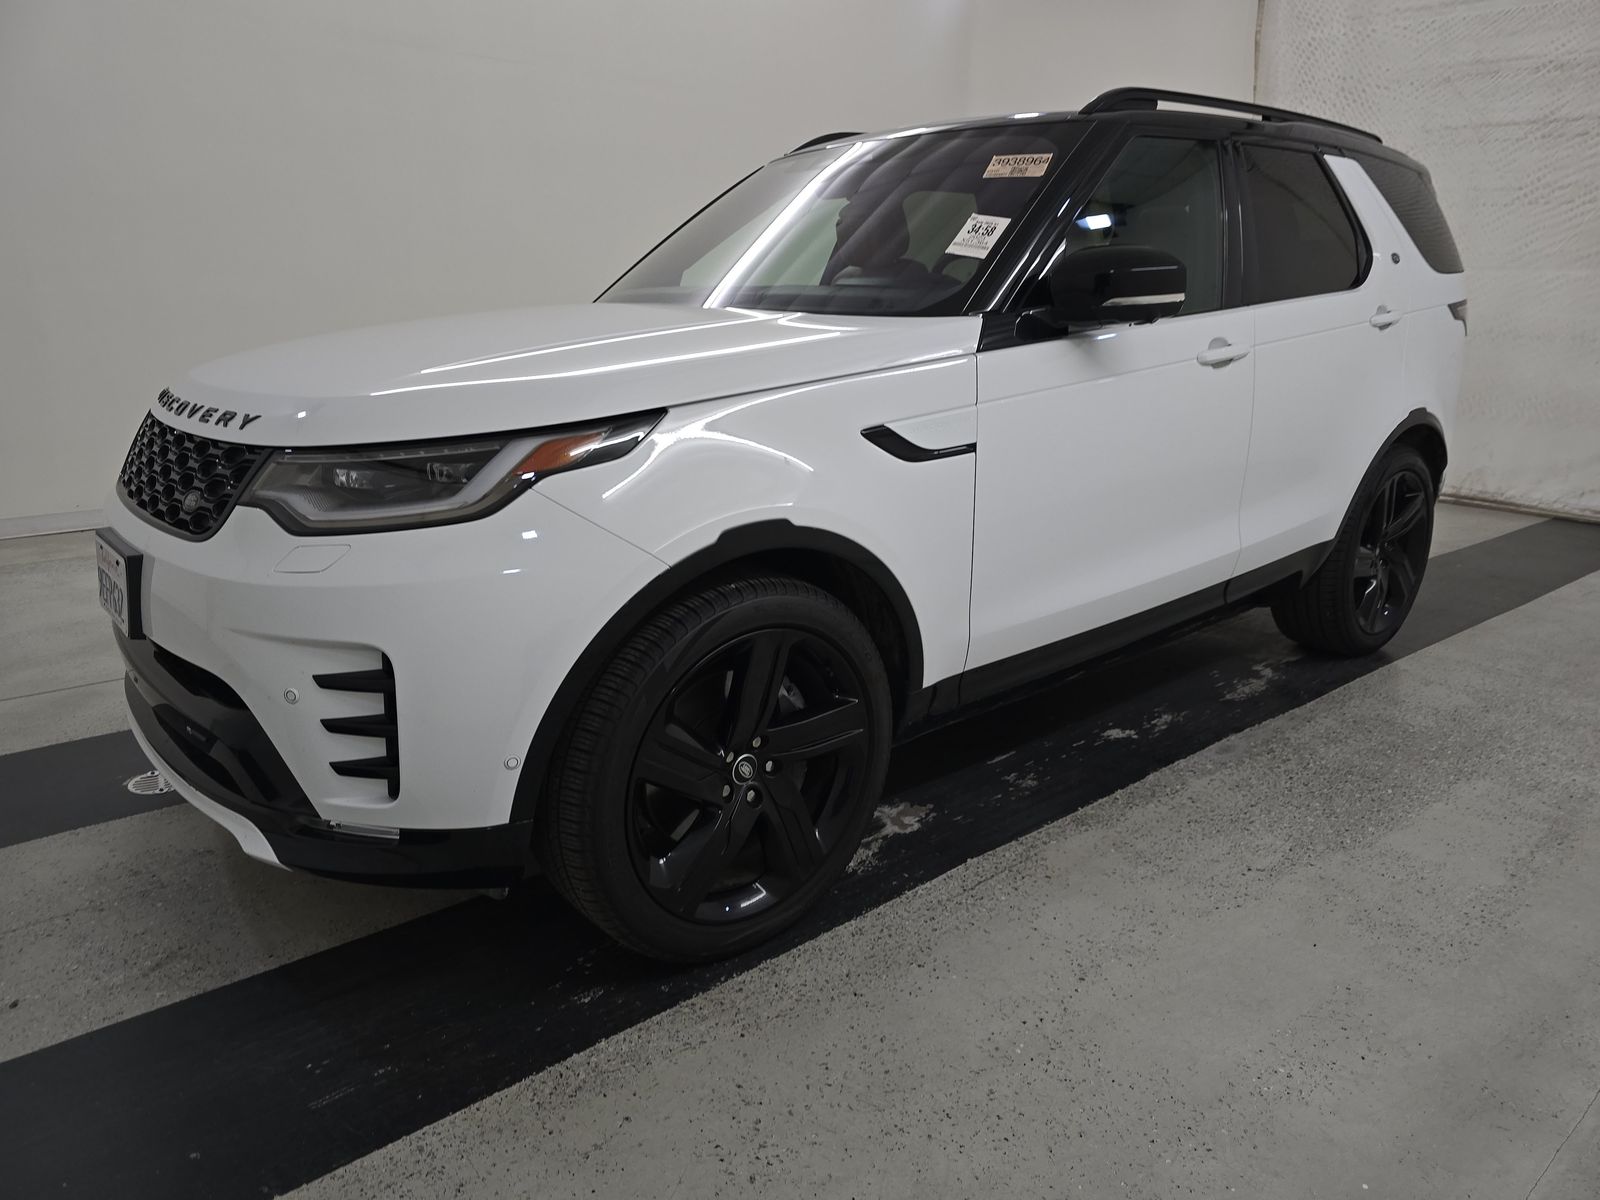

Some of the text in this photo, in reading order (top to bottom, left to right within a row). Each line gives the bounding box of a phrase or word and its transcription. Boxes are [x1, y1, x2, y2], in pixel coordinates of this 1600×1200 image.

[992, 156, 1050, 167] 3938964
[967, 223, 997, 237] 34:58
[157, 387, 262, 430] DISCOVERY
